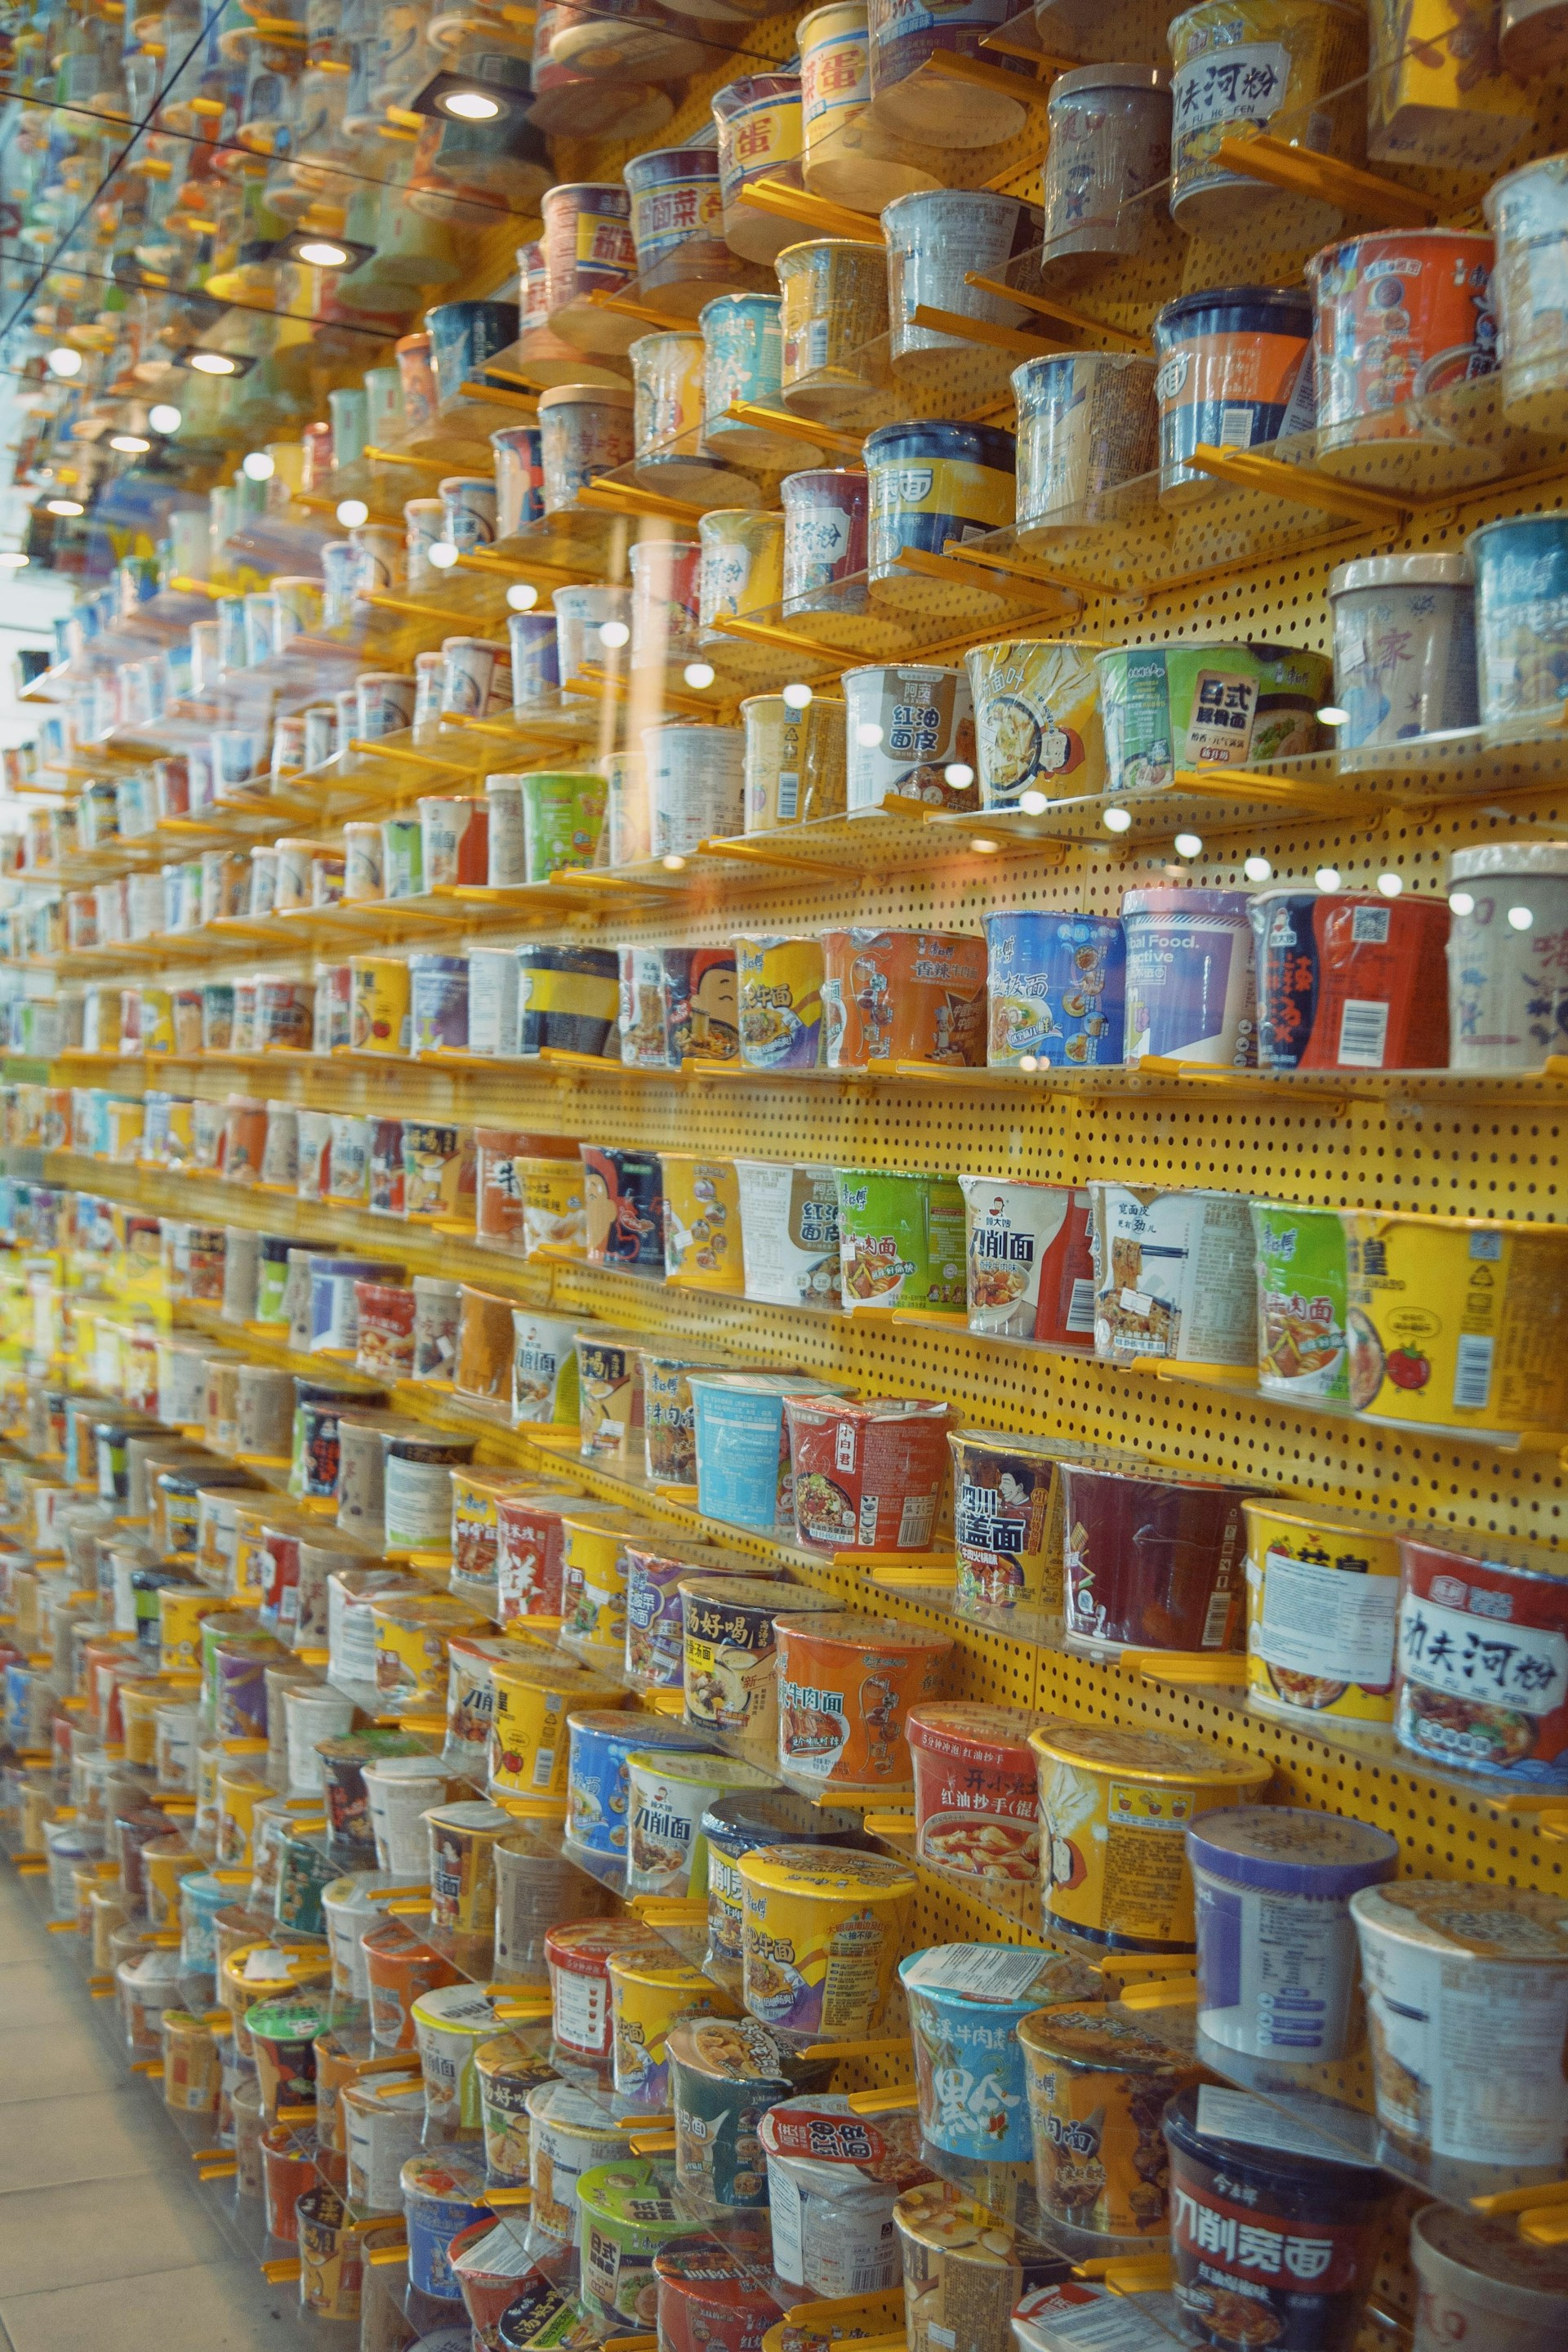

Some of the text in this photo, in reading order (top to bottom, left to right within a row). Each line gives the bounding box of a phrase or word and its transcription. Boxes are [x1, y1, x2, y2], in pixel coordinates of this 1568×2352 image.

[1178, 62, 1279, 115] 夫河粉
[1193, 114, 1204, 124] FU
[1233, 105, 1255, 115] FEN
[1199, 678, 1253, 712] 日式
[892, 706, 940, 728] 红油
[1196, 705, 1249, 731] 豚骨面
[889, 728, 938, 751] 面皮
[1148, 934, 1200, 949] Food.
[842, 1183, 869, 1212] 康师傅
[1118, 1202, 1151, 1218] 宽面皮
[985, 1216, 1012, 1229] 顾大嫂
[969, 1227, 1036, 1263] 刀削面
[839, 1425, 853, 1467] 小白君
[687, 1606, 749, 1648] 汤好喝
[1405, 1608, 1557, 1691] 功夫河粉
[922, 1733, 1005, 1765] 5分钟冲泡 红油抄手
[633, 1804, 693, 1842] 刀削面
[807, 2119, 840, 2158] 红油
[838, 2123, 873, 2160] 面皮
